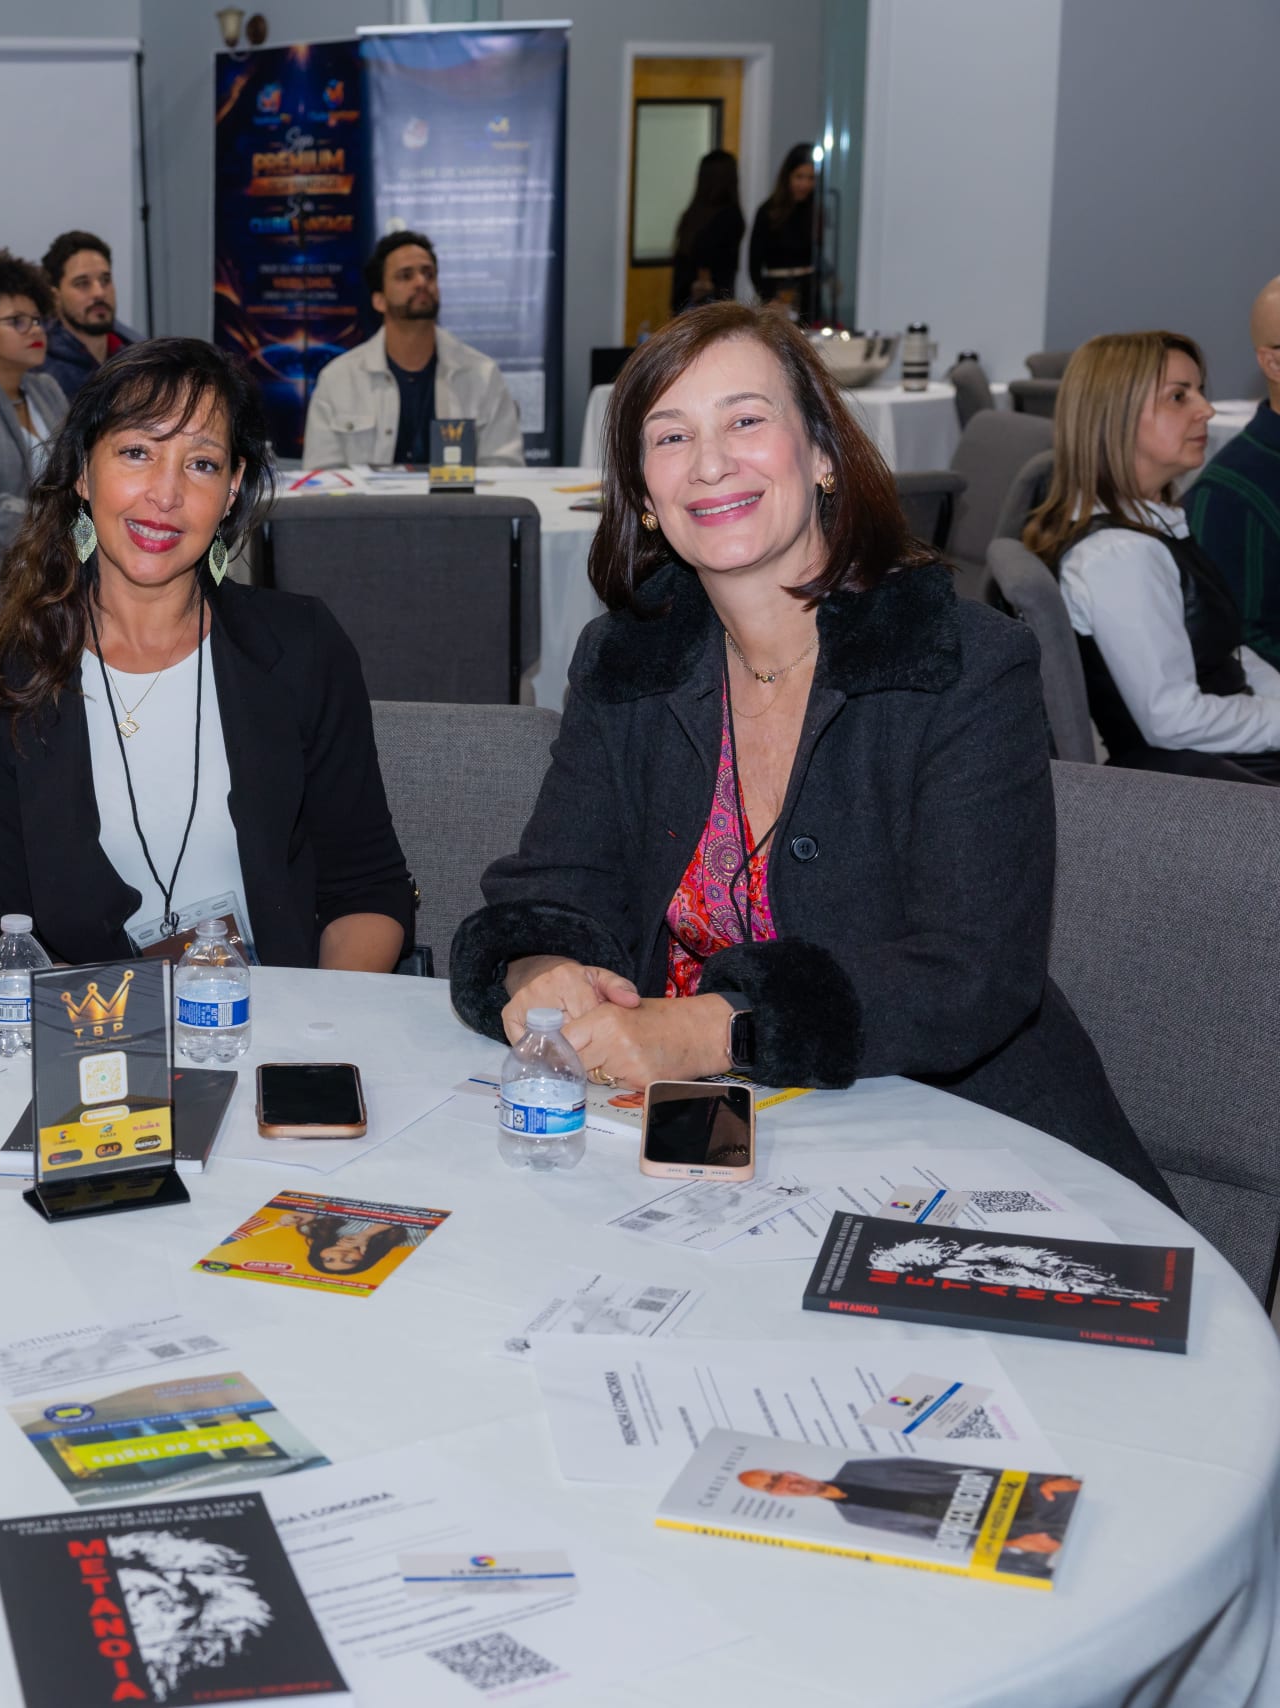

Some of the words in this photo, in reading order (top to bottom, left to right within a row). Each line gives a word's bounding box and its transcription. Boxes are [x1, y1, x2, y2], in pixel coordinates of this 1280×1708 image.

[829, 1300, 879, 1315] METANOIA
[867, 1270, 1161, 1313] METANOIA
[66, 1539, 149, 1703] METANOIA
